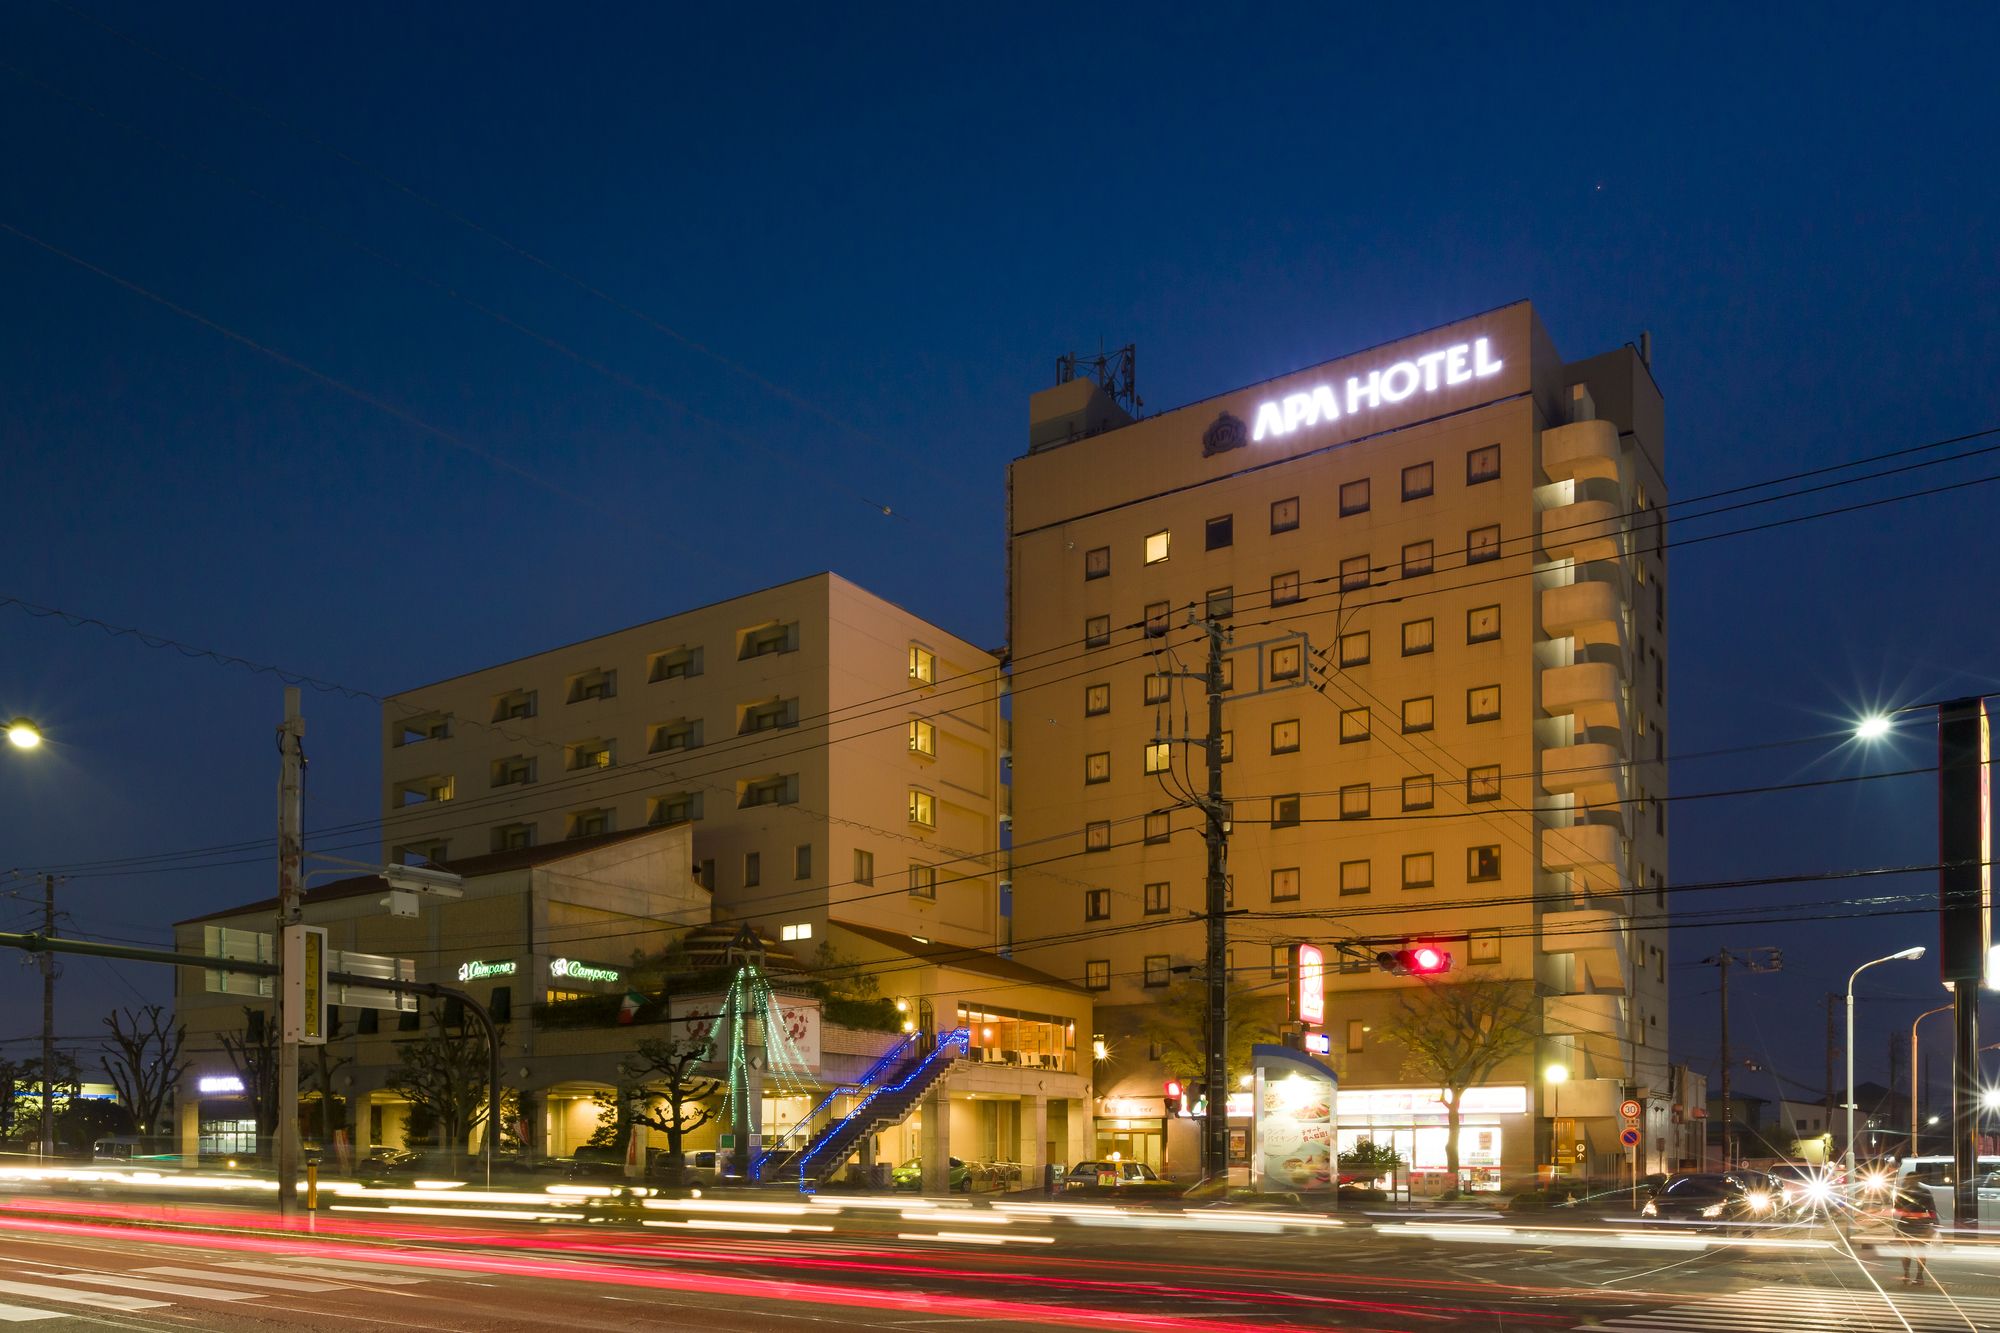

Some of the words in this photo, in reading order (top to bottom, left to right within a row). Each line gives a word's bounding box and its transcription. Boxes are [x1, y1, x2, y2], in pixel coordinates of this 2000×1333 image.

[1252, 385, 1339, 441] APA
[1346, 337, 1502, 414] HOTEL
[567, 960, 618, 982] Campana
[1624, 1105, 1636, 1114] 30
